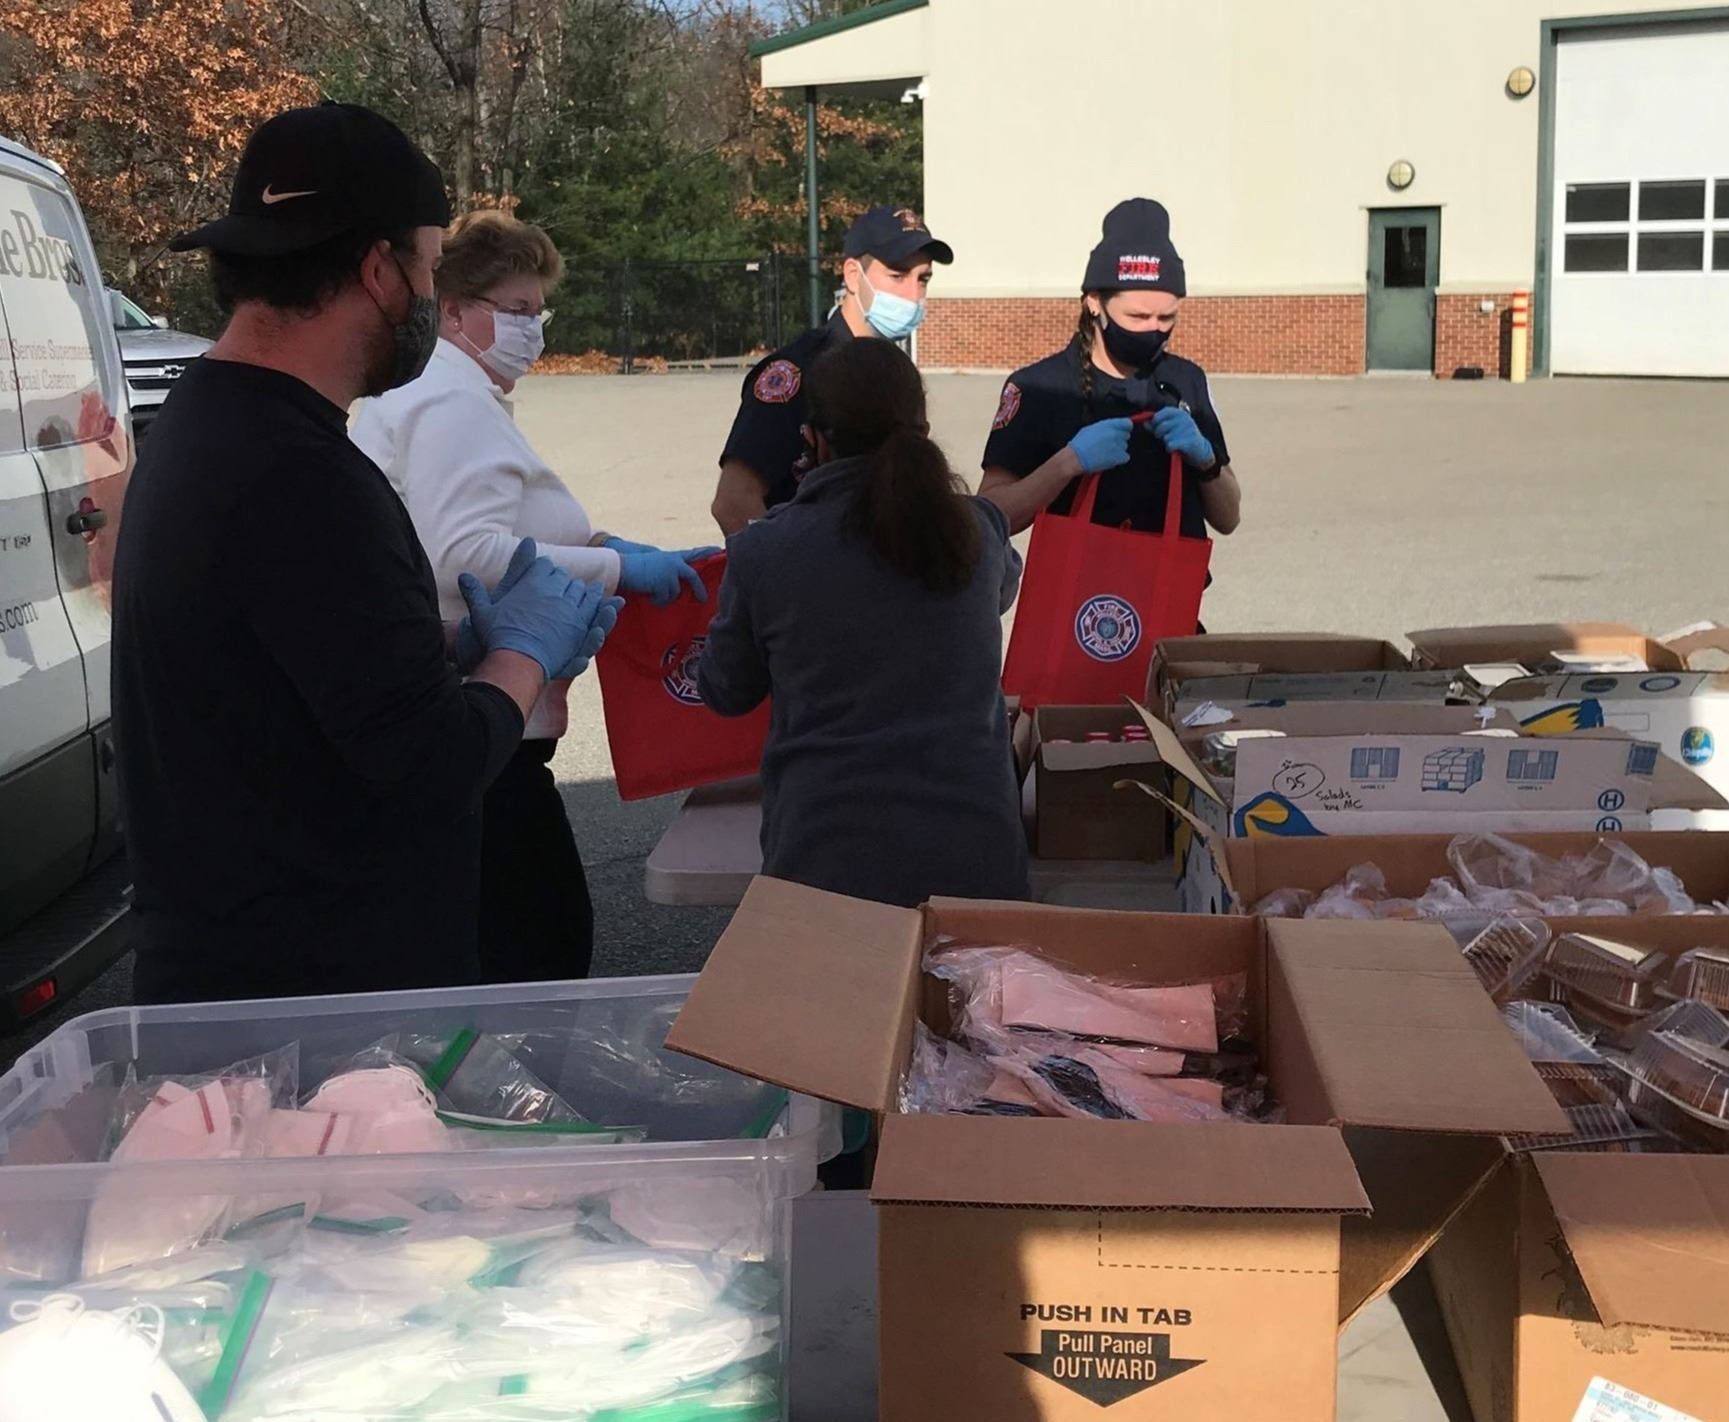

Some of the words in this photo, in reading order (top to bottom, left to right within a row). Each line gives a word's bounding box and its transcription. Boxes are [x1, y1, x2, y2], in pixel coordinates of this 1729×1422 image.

[1118, 262, 1160, 276] FIRE
[1316, 787, 1351, 801] Salads
[1343, 799, 1364, 810] MC
[1020, 1304, 1092, 1322] PUSH
[1101, 1307, 1128, 1323] IN
[1137, 1308, 1192, 1326] TAB
[1059, 1333, 1094, 1352] Pull
[1101, 1335, 1152, 1354] Panel
[1053, 1356, 1157, 1380] OUTWARD
